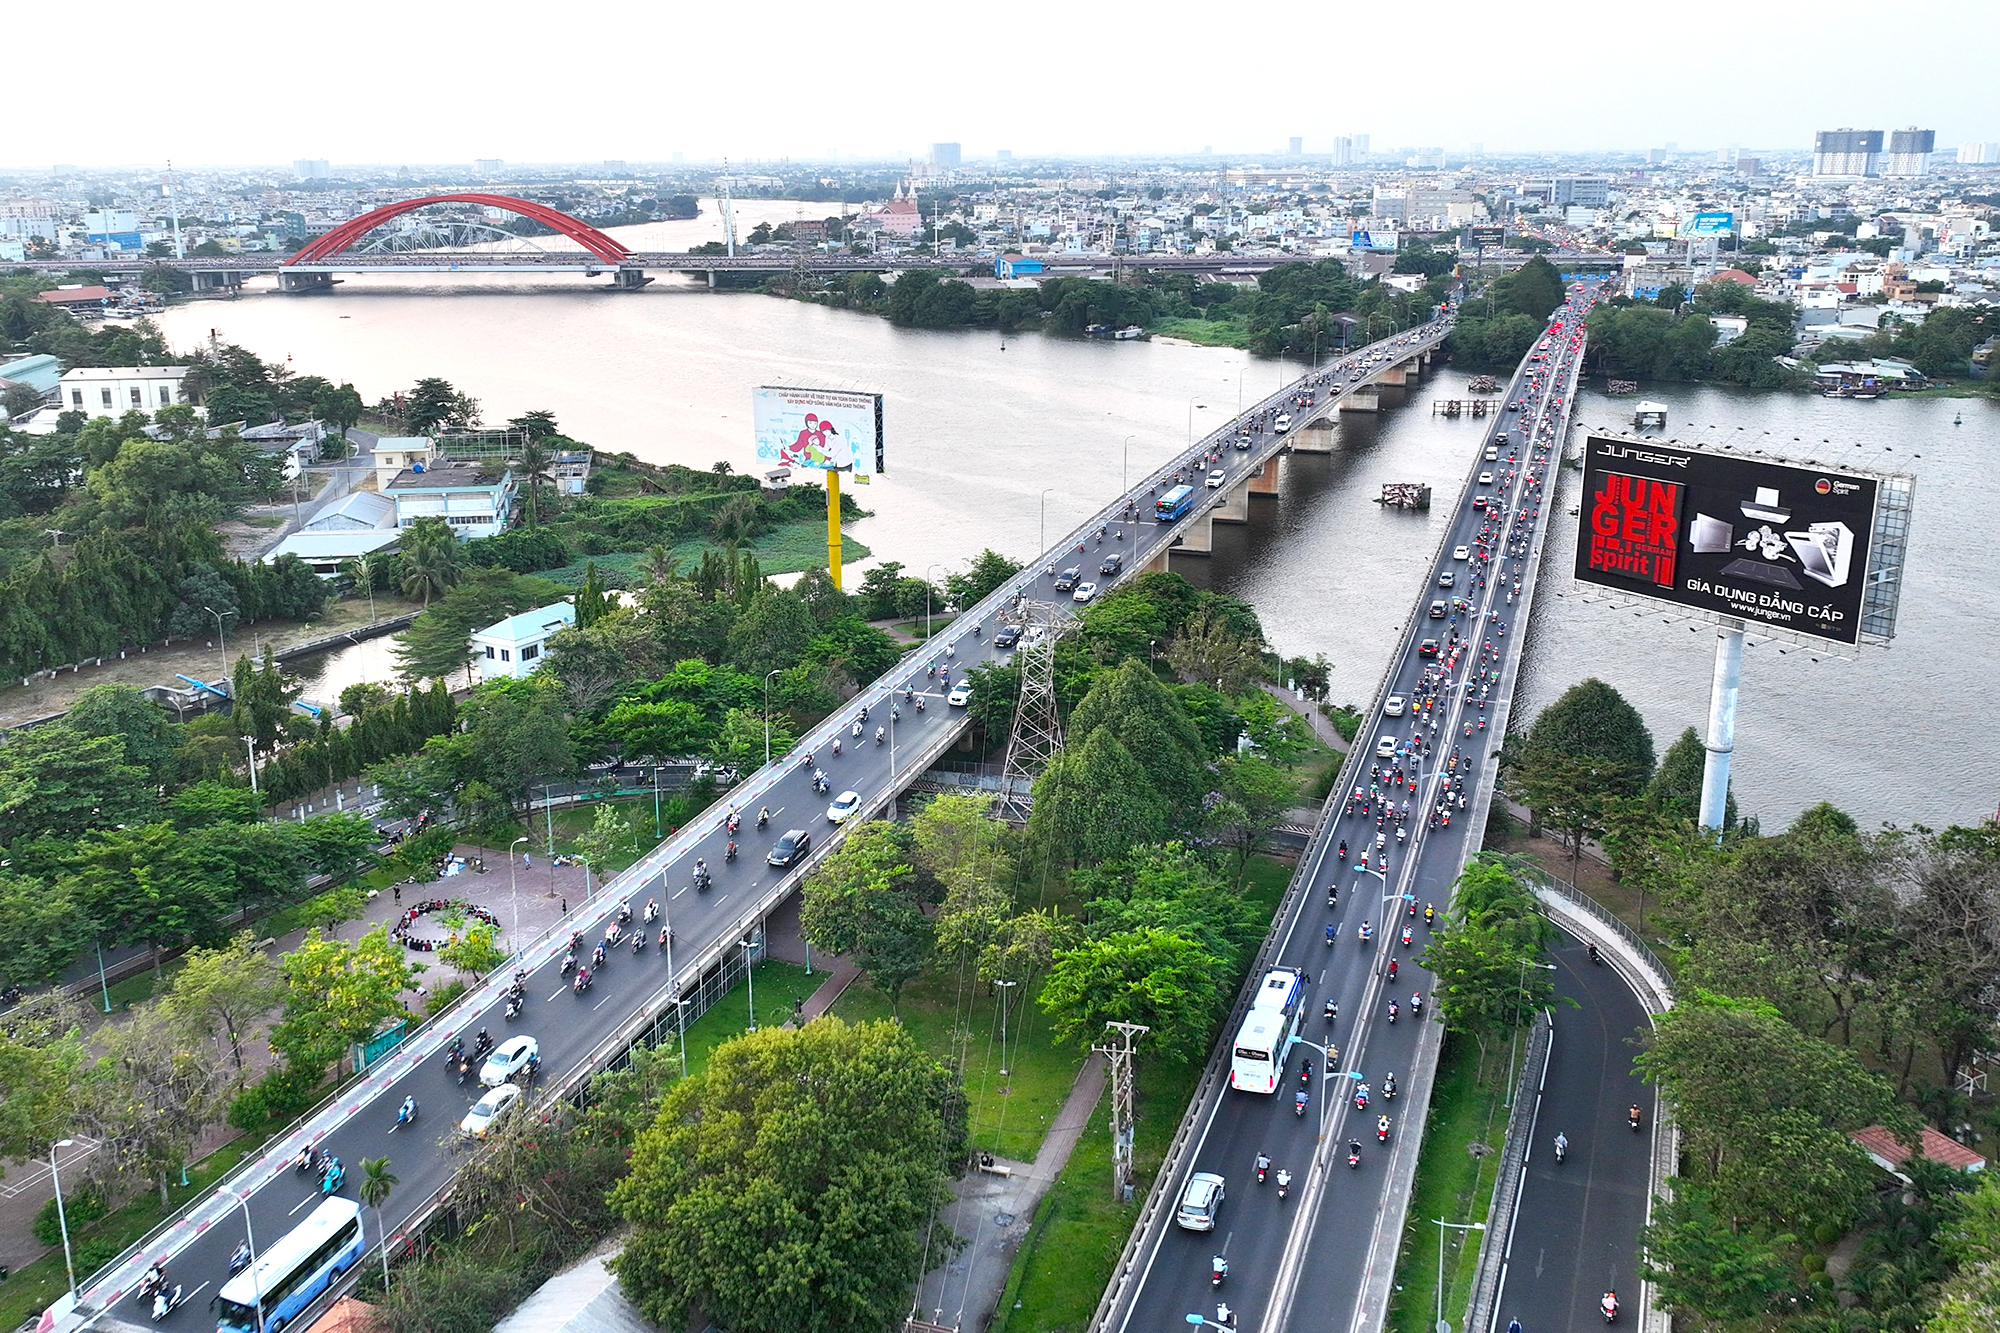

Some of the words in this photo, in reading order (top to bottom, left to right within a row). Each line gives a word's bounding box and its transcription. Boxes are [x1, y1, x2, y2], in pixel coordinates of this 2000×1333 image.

[1596, 444, 1688, 468] JUNGER
[1832, 486, 1850, 496] Spirit
[1833, 480, 1860, 491] German
[1634, 543, 1673, 556] GERMAN
[1591, 548, 1649, 575] spirit
[1714, 585, 1756, 604] DỤNG
[1759, 591, 1804, 614] ĐẲNG
[1807, 603, 1844, 622] CẤP
[1730, 601, 1791, 622] www.junger.vn
